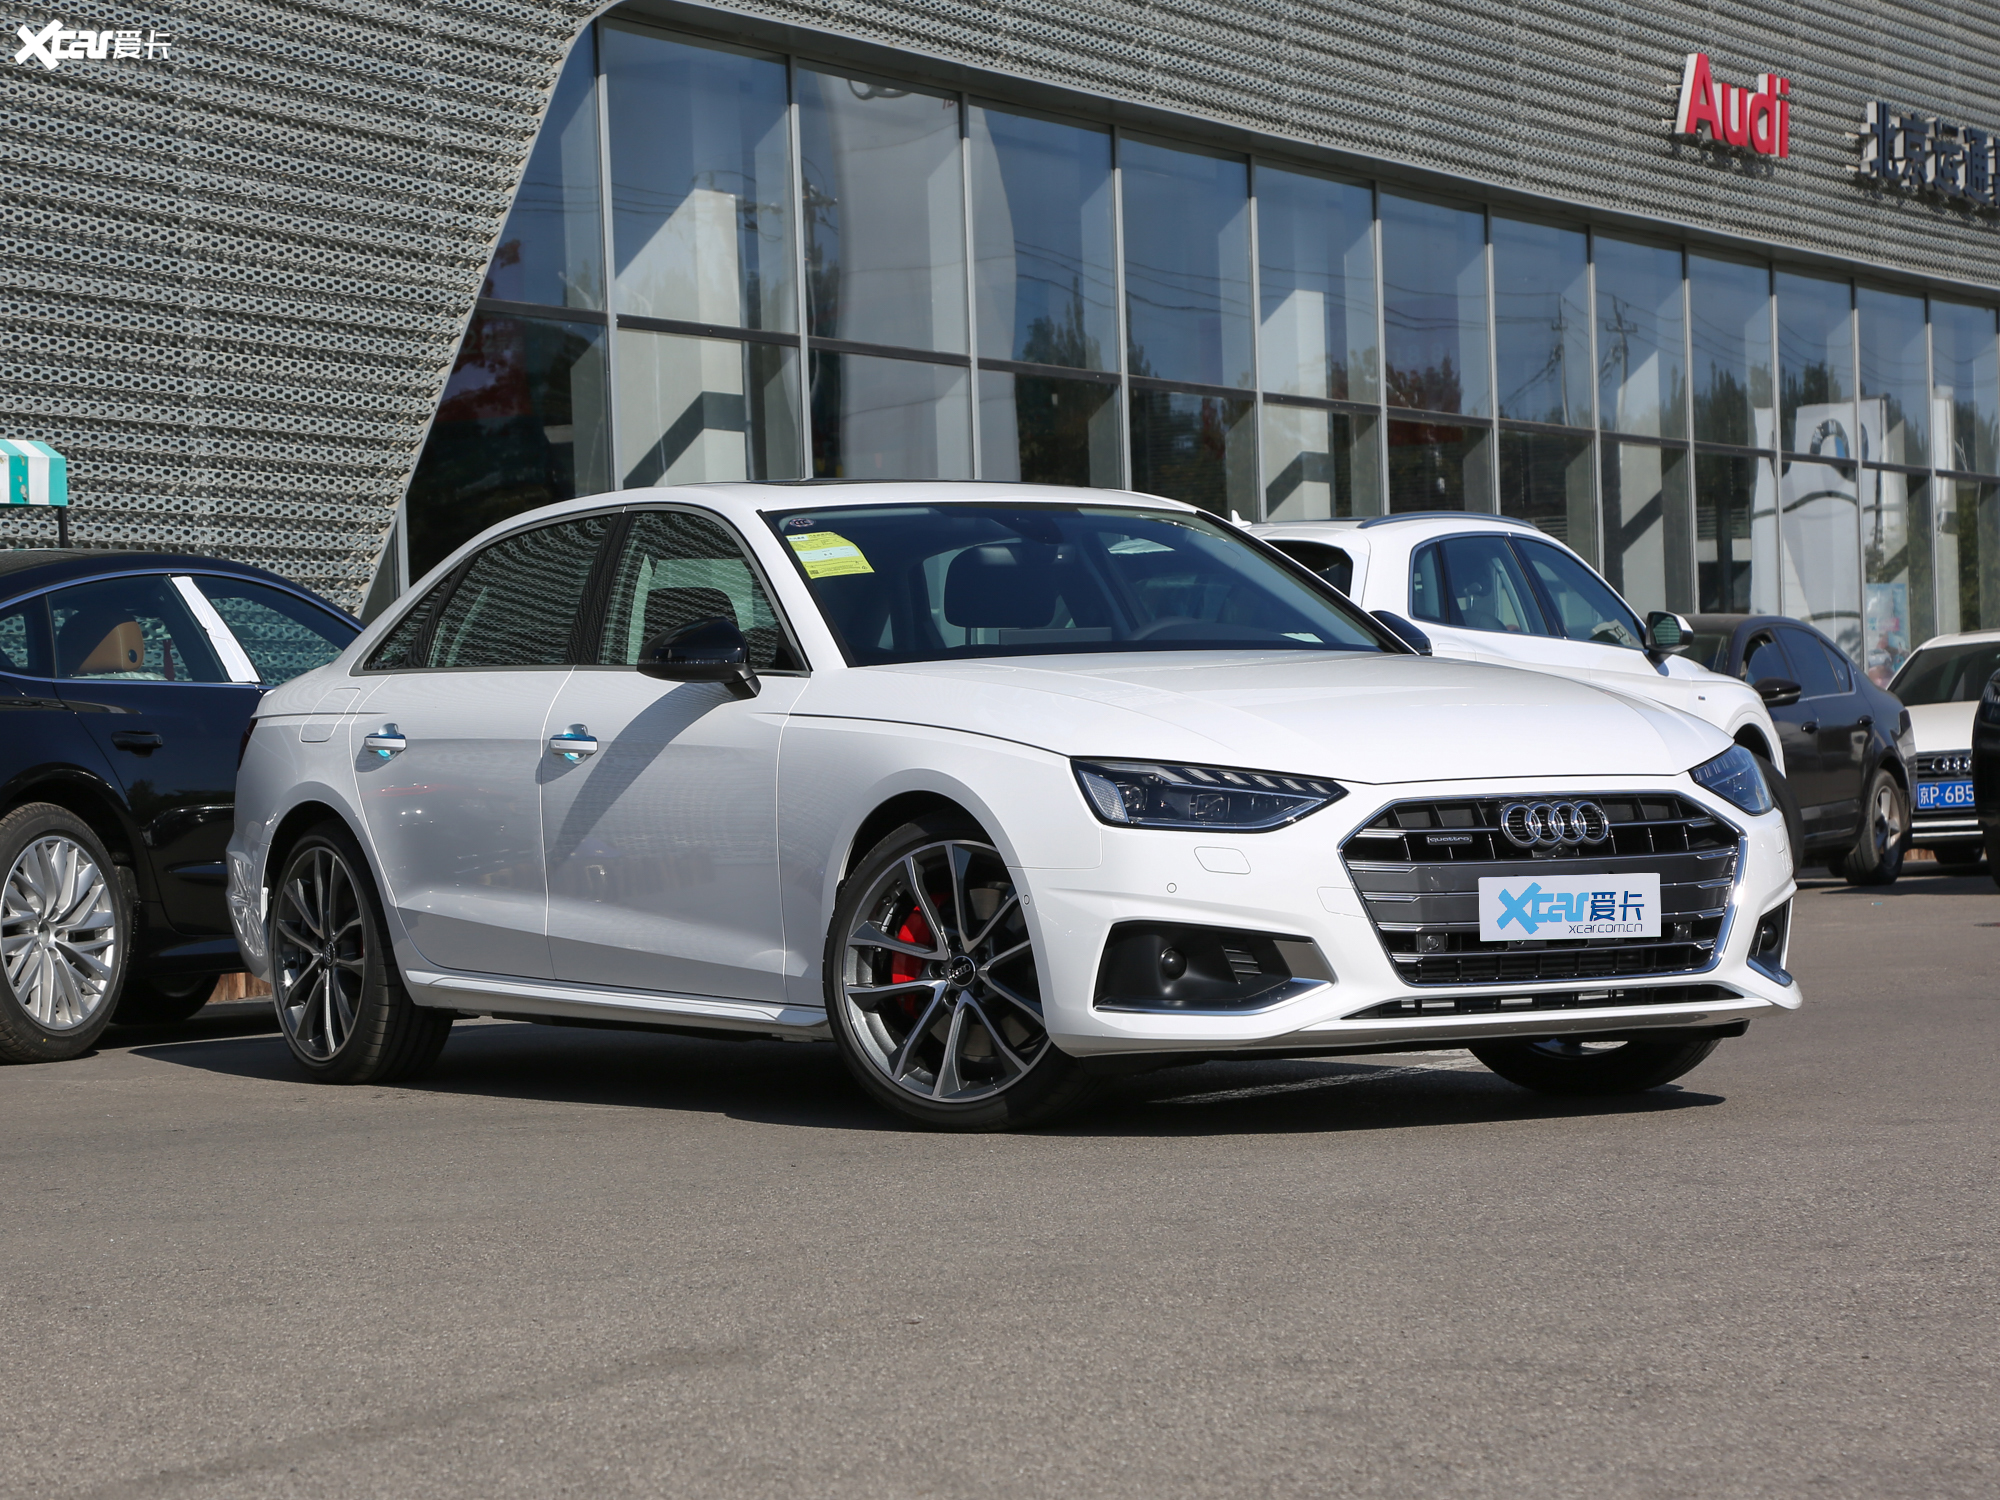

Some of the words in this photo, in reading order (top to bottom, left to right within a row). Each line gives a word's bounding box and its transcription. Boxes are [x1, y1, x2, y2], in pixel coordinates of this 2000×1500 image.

[1675, 53, 1789, 158] Audi
[1861, 101, 2000, 207] 北京运通
[1568, 923, 1643, 934] xcar.com.cn
